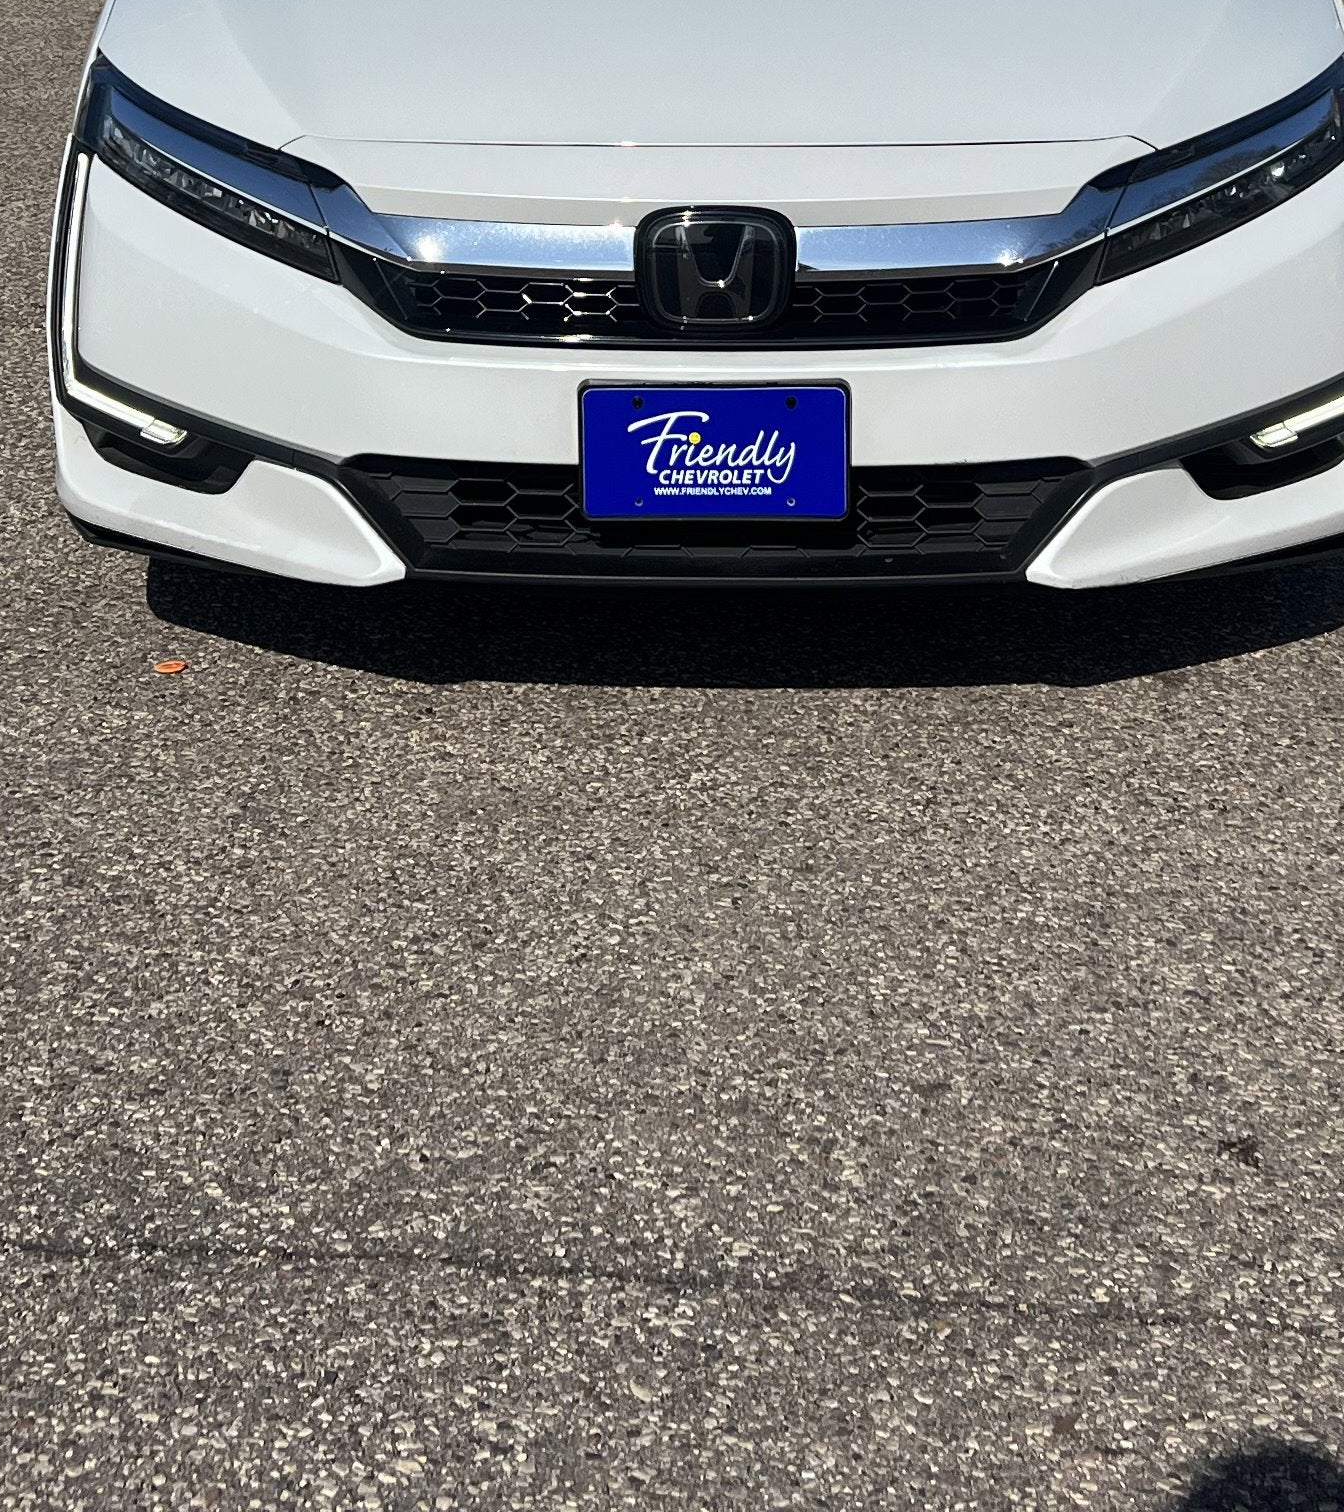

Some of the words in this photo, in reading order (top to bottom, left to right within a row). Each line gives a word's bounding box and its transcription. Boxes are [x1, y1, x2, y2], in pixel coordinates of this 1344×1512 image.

[627, 410, 796, 484] Friendly
[658, 468, 765, 485] CHEVROLET
[653, 486, 772, 496] WWW.FRIENDLYCHEV.COM
